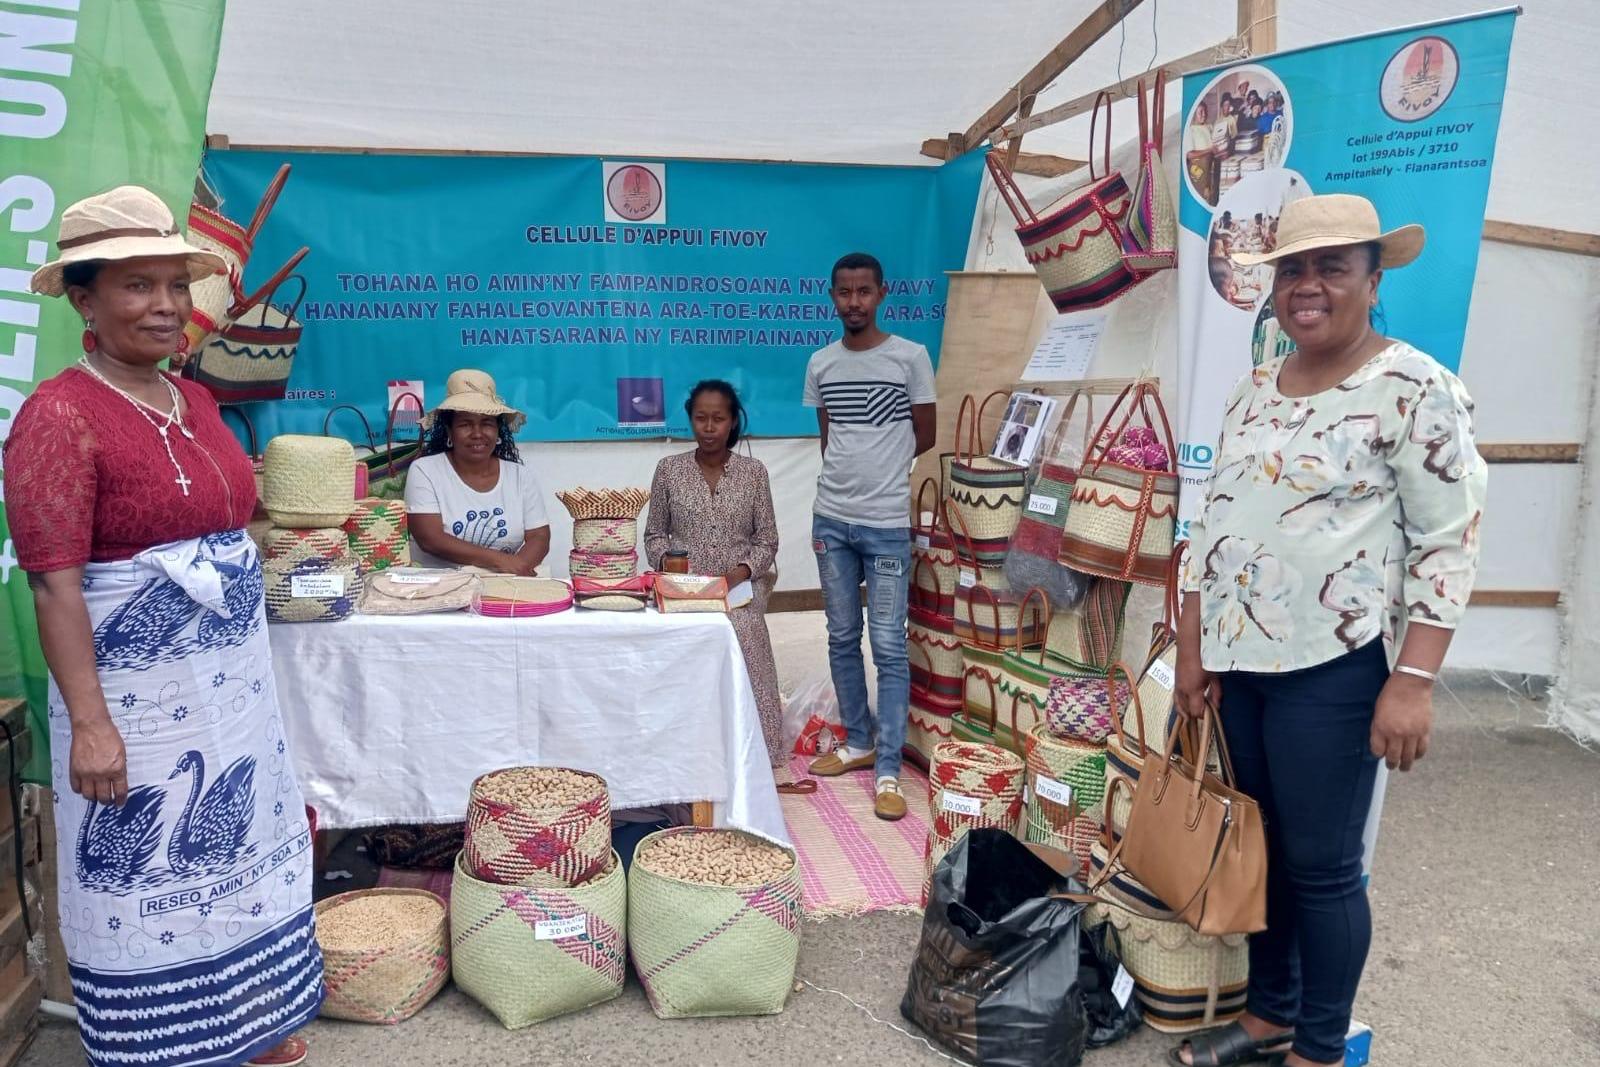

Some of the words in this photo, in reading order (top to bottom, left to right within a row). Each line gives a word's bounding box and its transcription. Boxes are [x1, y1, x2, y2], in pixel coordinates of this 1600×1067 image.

[1398, 84, 1440, 111] FIVOY
[1347, 134, 1383, 147] Cellule
[1436, 123, 1474, 135] FIVOY
[1428, 142, 1459, 155] 3710
[1405, 158, 1487, 173] Fianarantsoa
[623, 199, 651, 214] FIVOY
[526, 226, 616, 244] CELLULE
[623, 227, 703, 246] D'APPUI
[710, 230, 768, 248] FIVOY
[337, 273, 439, 292] TOHANA
[446, 274, 480, 292] HO
[487, 273, 582, 292] AMIN'NY
[590, 273, 792, 296] FAMPANDROSOANA
[799, 278, 827, 295] NY
[882, 278, 937, 296] VAVY
[305, 301, 440, 321] HANANANY
[448, 300, 652, 320] FAHALEOVANTENA
[461, 327, 627, 346] HANATSARANA
[634, 328, 662, 345] NY
[670, 329, 835, 346] FARIMPIAINANY
[284, 387, 325, 400] aires
[147, 891, 201, 912] RESEO
[270, 846, 292, 867] SOA
[298, 834, 309, 850] NY
